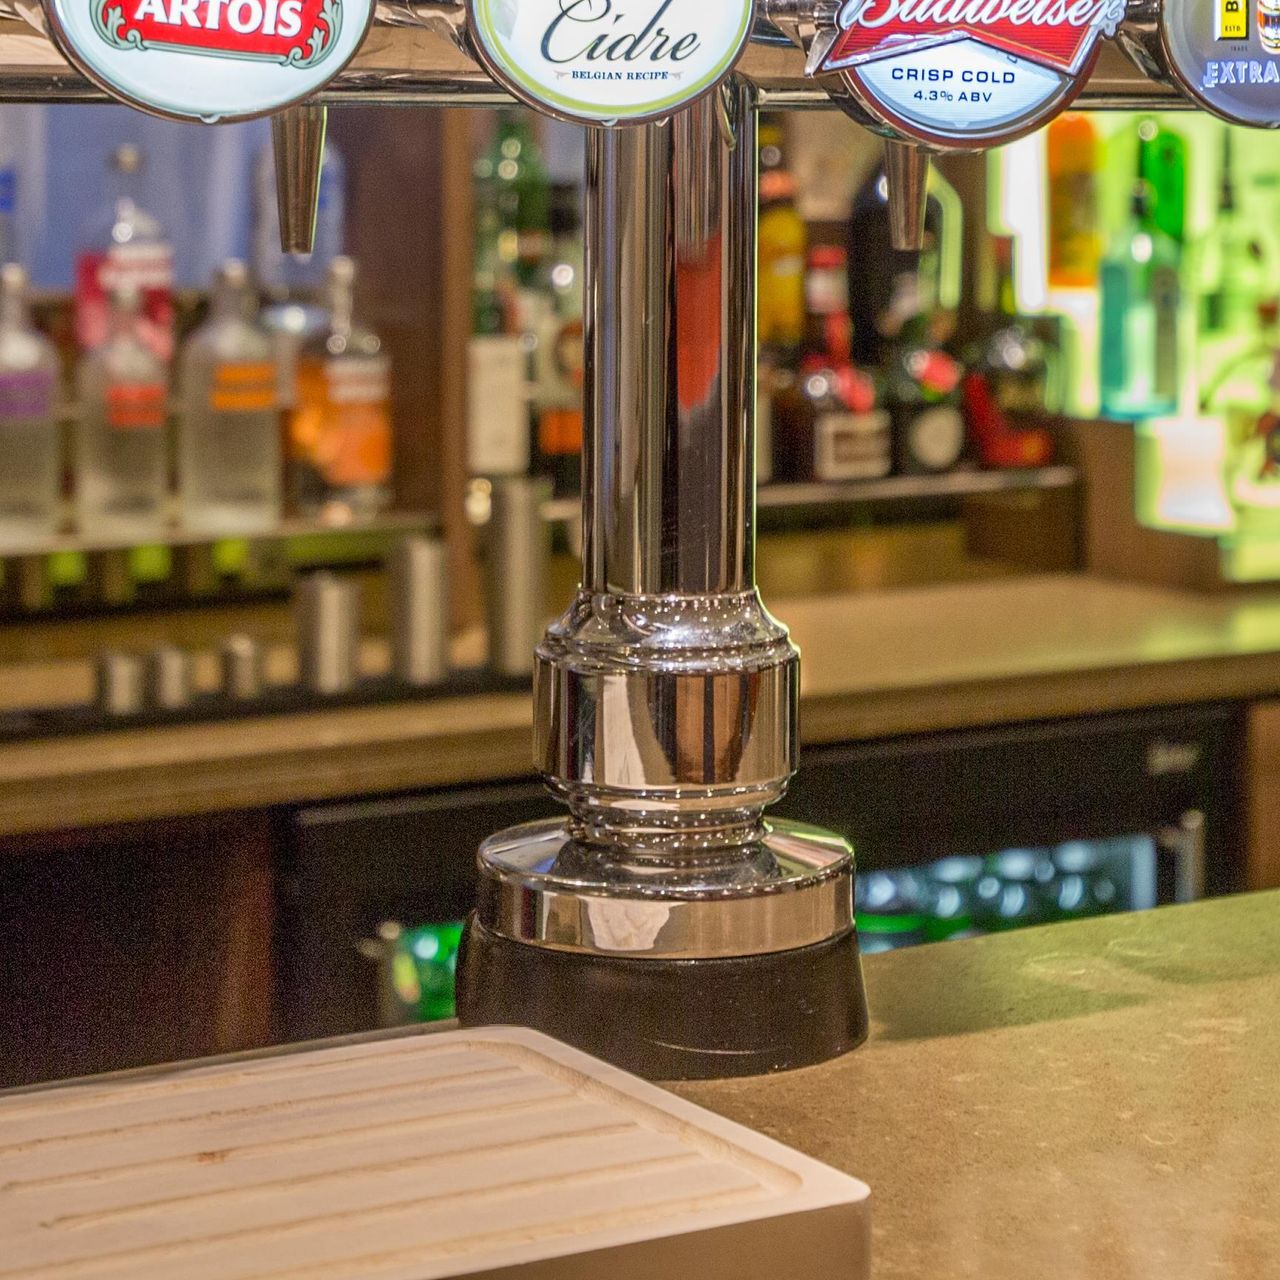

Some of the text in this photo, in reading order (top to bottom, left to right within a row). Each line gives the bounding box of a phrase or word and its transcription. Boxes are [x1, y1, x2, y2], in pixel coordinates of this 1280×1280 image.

[571, 70, 669, 81] BELGIAN RECIPE
[891, 67, 1016, 84] CRISP COLD
[1205, 58, 1280, 87] EXTRA
[913, 90, 993, 102] 4.3% ABV
